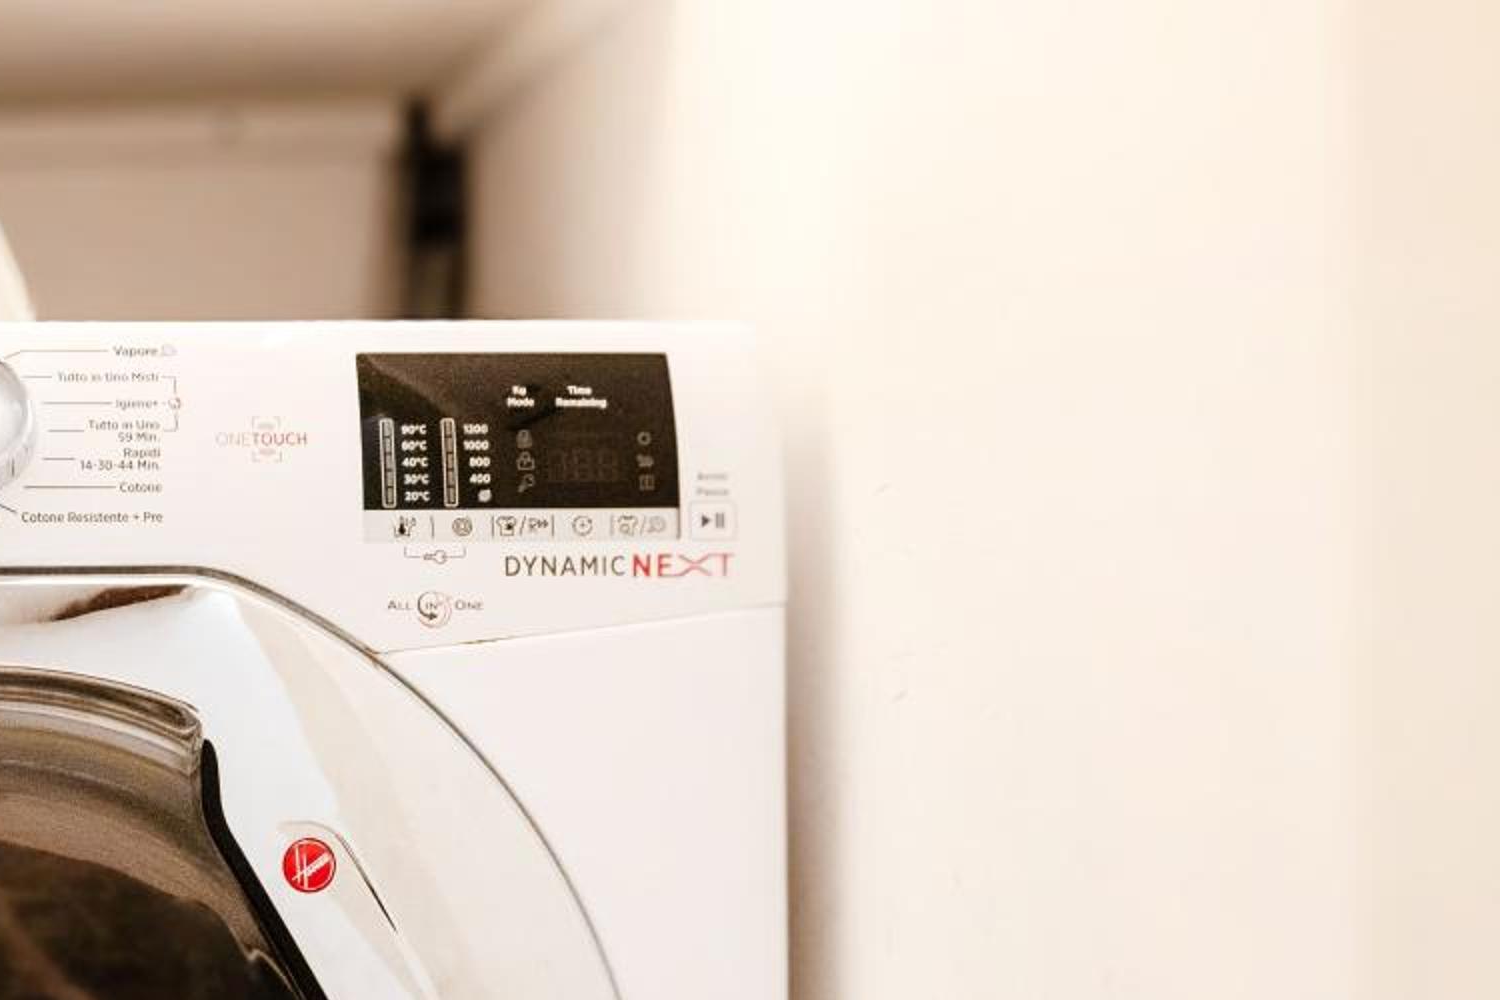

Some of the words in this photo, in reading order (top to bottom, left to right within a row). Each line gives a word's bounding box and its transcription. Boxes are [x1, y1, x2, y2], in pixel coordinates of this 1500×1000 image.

[113, 345, 158, 358] Vapore
[105, 372, 130, 383] Uno
[132, 371, 159, 383] Misti
[88, 420, 118, 431] Tutto
[122, 420, 133, 431] in
[135, 420, 161, 431] Uno
[118, 432, 133, 443] 59
[463, 440, 489, 450] 1000
[123, 447, 161, 460] Rapidi
[402, 457, 429, 467] 40°C
[119, 482, 162, 493] Cotone
[405, 491, 431, 501] 20°C
[21, 512, 64, 523] Cotone
[67, 512, 130, 523] Resistente
[143, 512, 163, 523] Pre
